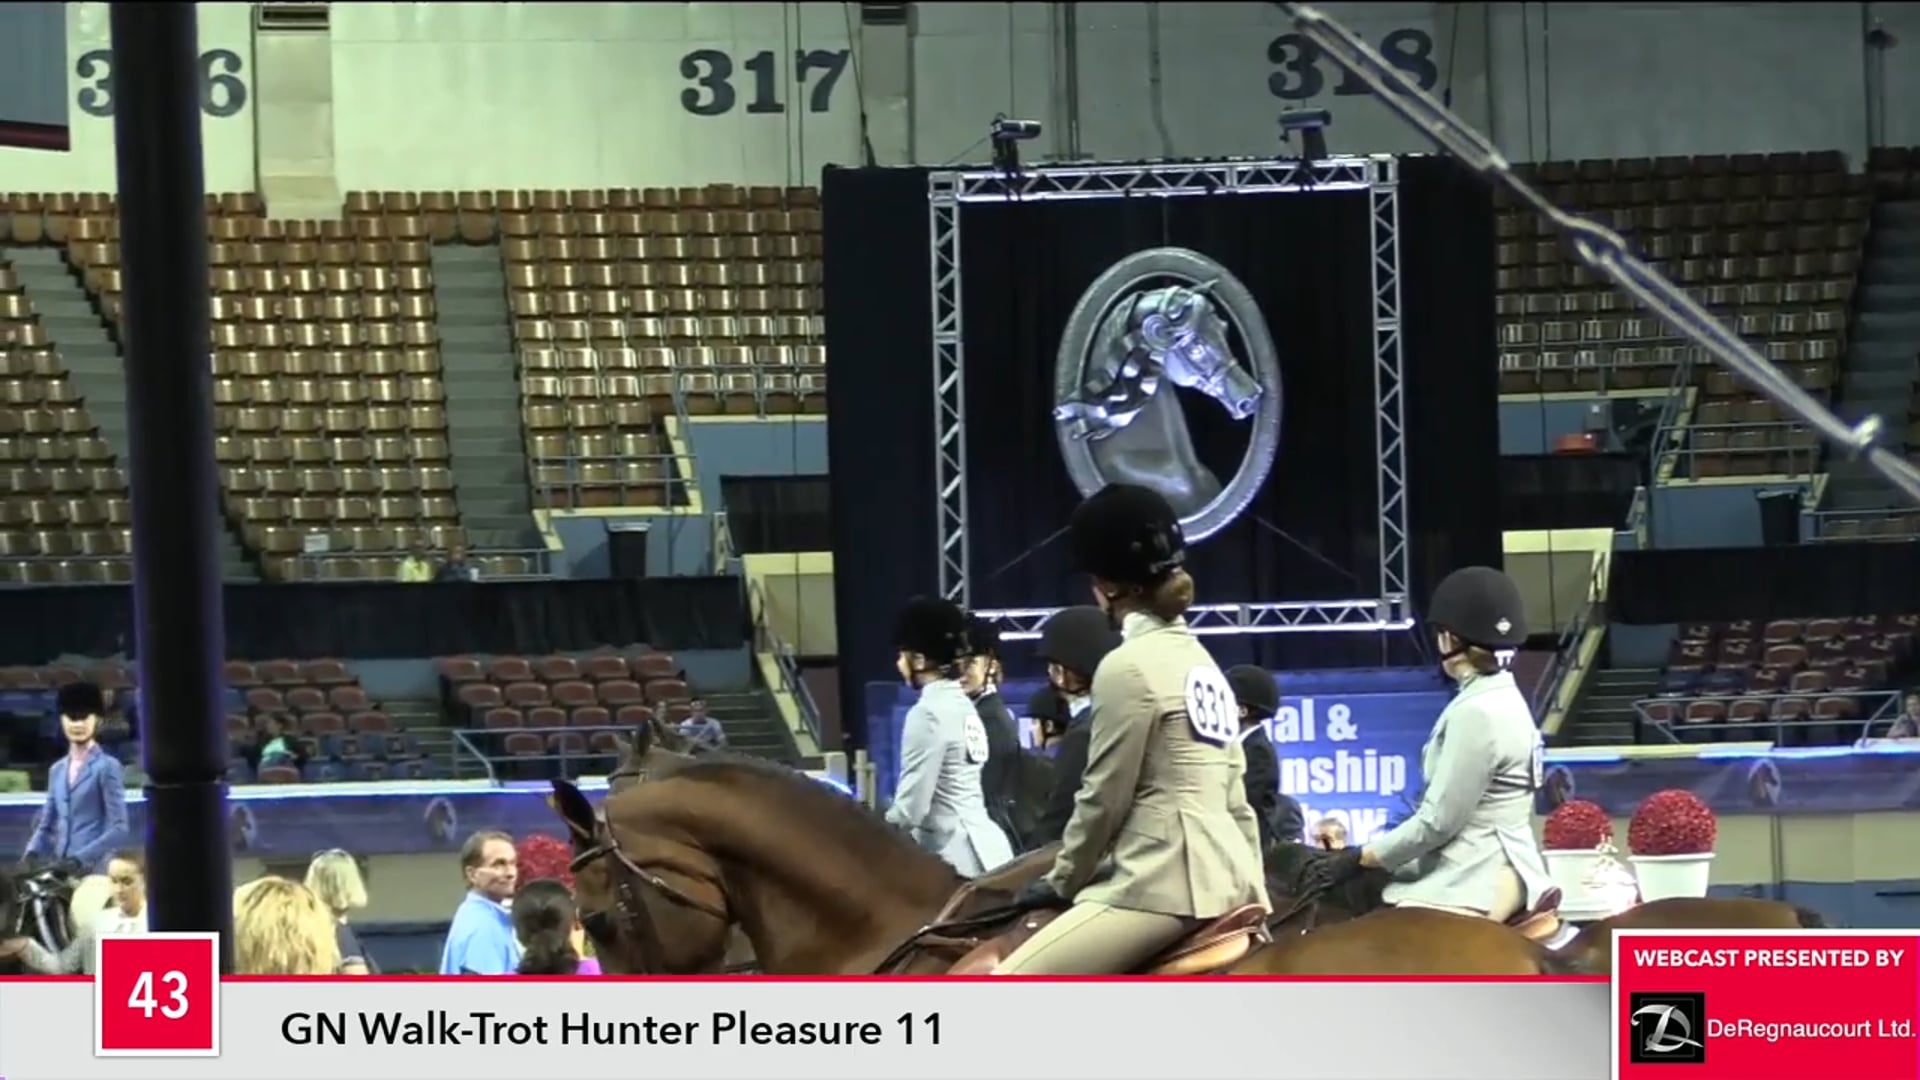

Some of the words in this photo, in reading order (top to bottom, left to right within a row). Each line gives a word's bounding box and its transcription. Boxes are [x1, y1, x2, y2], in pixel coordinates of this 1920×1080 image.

[76, 49, 247, 117] 36
[680, 49, 850, 115] 317
[1193, 680, 1232, 737] 831
[1326, 703, 1358, 741] &
